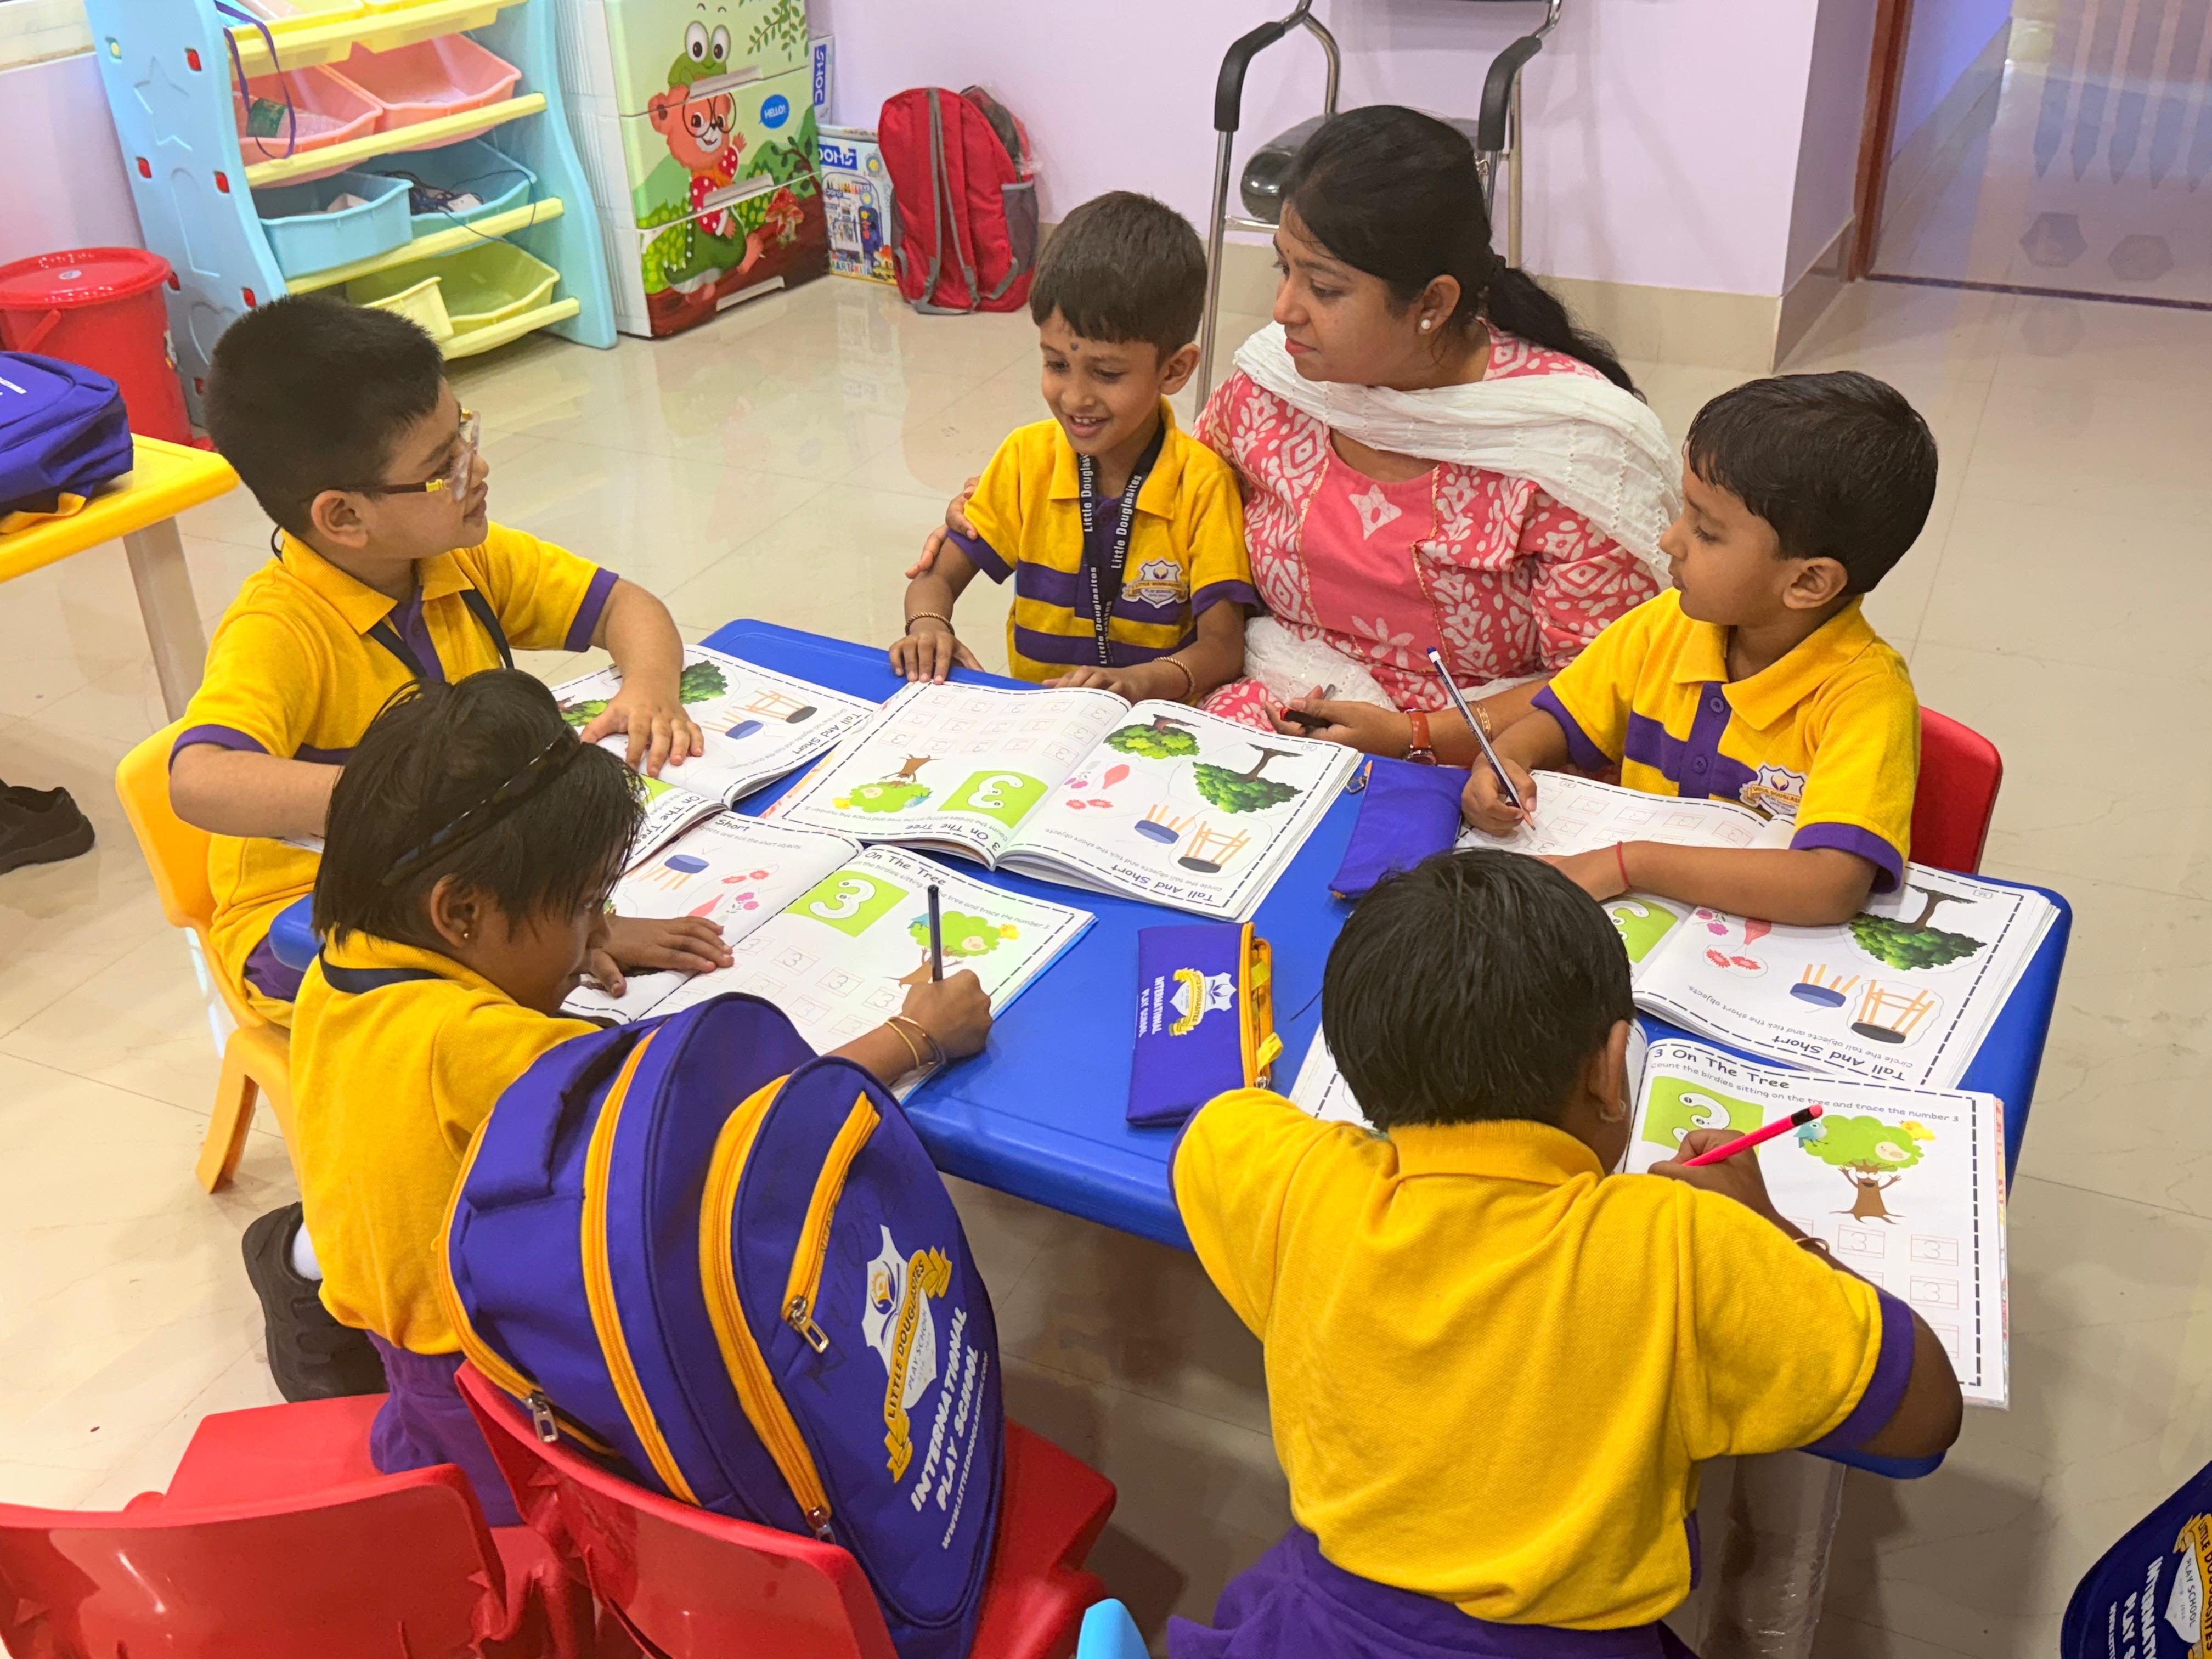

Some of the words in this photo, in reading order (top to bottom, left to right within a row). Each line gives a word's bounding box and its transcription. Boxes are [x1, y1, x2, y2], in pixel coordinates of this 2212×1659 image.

[764, 105, 786, 119] HELLO!
[1116, 475, 1142, 536] Douglasites
[1083, 500, 1093, 532] Little
[1111, 538, 1127, 569] Little
[1091, 567, 1103, 631] Douglasites
[1097, 633, 1107, 664] Little
[842, 713, 862, 725] Tall
[822, 724, 839, 737] And
[792, 737, 821, 754] Short
[682, 795, 700, 804] On
[660, 807, 685, 820] The
[715, 819, 751, 832] Short
[940, 823, 962, 832] The
[970, 828, 989, 840] On
[1074, 837, 1095, 847] short
[992, 842, 1000, 851] 3
[1096, 845, 1108, 854] the
[1110, 852, 1123, 860] tick
[1124, 859, 1140, 867] and
[865, 851, 882, 860] On
[888, 856, 911, 869] The
[917, 867, 946, 885] Tree
[1111, 865, 1151, 884] Short
[1141, 865, 1169, 878] objects
[1154, 882, 1184, 893] And
[809, 878, 877, 920] 3
[877, 865, 899, 877] birdies
[900, 874, 923, 888] sitting
[948, 895, 964, 904] tree
[980, 907, 1000, 917] trace
[1014, 917, 1043, 927] number
[1187, 890, 1214, 902] Tall
[1141, 988, 1150, 1008] PLAY
[1152, 976, 1165, 1035] INTERNATIONAL
[1722, 1005, 1747, 1018] short
[1138, 1008, 1148, 1038] SCHOOL
[1749, 1016, 1764, 1025] the
[1767, 1022, 1784, 1030] tick
[1787, 1028, 1805, 1036] and
[1771, 1035, 1824, 1054] Short
[1808, 1034, 1843, 1047] objects
[1844, 1045, 1863, 1053] tall
[1865, 1050, 1885, 1059] the
[1829, 1051, 1865, 1066] And
[1654, 1049, 1663, 1058] 3
[1673, 1049, 1697, 1062] On
[1706, 1057, 1737, 1076] The
[1747, 1072, 1790, 1089] Tree
[1871, 1064, 1905, 1081] Tall
[1683, 1064, 1699, 1074] the
[1701, 1071, 1733, 1088] birdies
[1736, 1084, 1769, 1098] sitting
[1787, 1094, 1807, 1103] the
[1808, 1098, 1830, 1106] tree
[1833, 1101, 1853, 1109] and
[1856, 1103, 1884, 1113] trace
[1909, 1110, 1950, 1121] number
[909, 1357, 918, 1390] PLAY
[888, 1359, 903, 1419] LITTLE
[911, 1307, 967, 1512] INTERNATIONAL
[936, 1436, 958, 1511] PLAY
[954, 1345, 978, 1438] SCHOOL
[2185, 1558, 2193, 1583] PLAY
[2187, 1585, 2196, 1628] SCHOOL
[2123, 1592, 2137, 1643] PLAY
